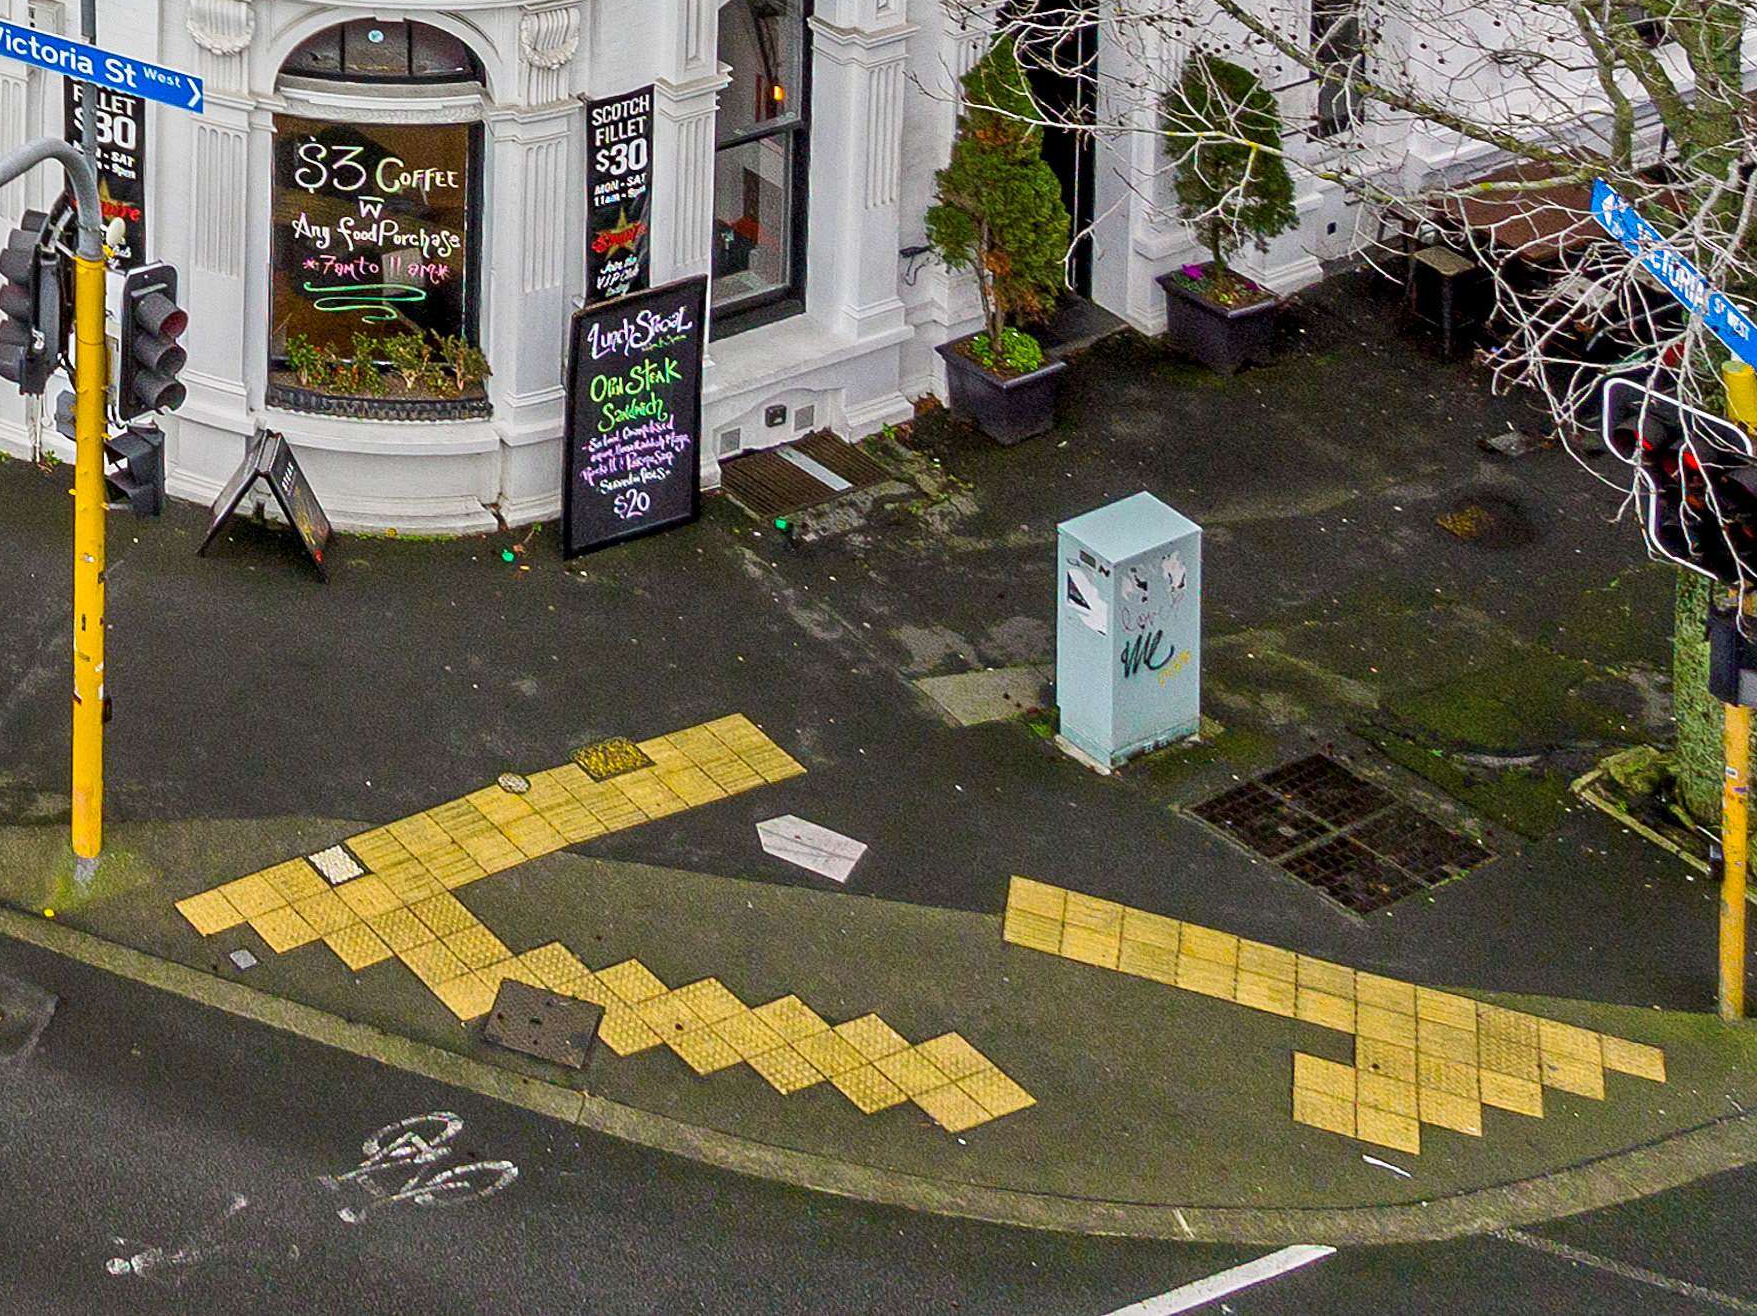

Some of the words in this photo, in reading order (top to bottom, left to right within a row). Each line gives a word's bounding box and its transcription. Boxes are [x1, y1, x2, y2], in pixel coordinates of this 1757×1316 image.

[105, 58, 138, 88] St
[143, 66, 181, 89] West
[73, 84, 137, 118] FLET
[591, 94, 650, 126] SCOTCH
[595, 116, 647, 146] FILLET
[295, 136, 366, 193] $3
[595, 137, 648, 175] $30
[594, 179, 620, 196] MON
[626, 172, 647, 187] SAT
[292, 212, 331, 249] Any
[337, 217, 377, 251] food
[613, 488, 651, 520] $20
